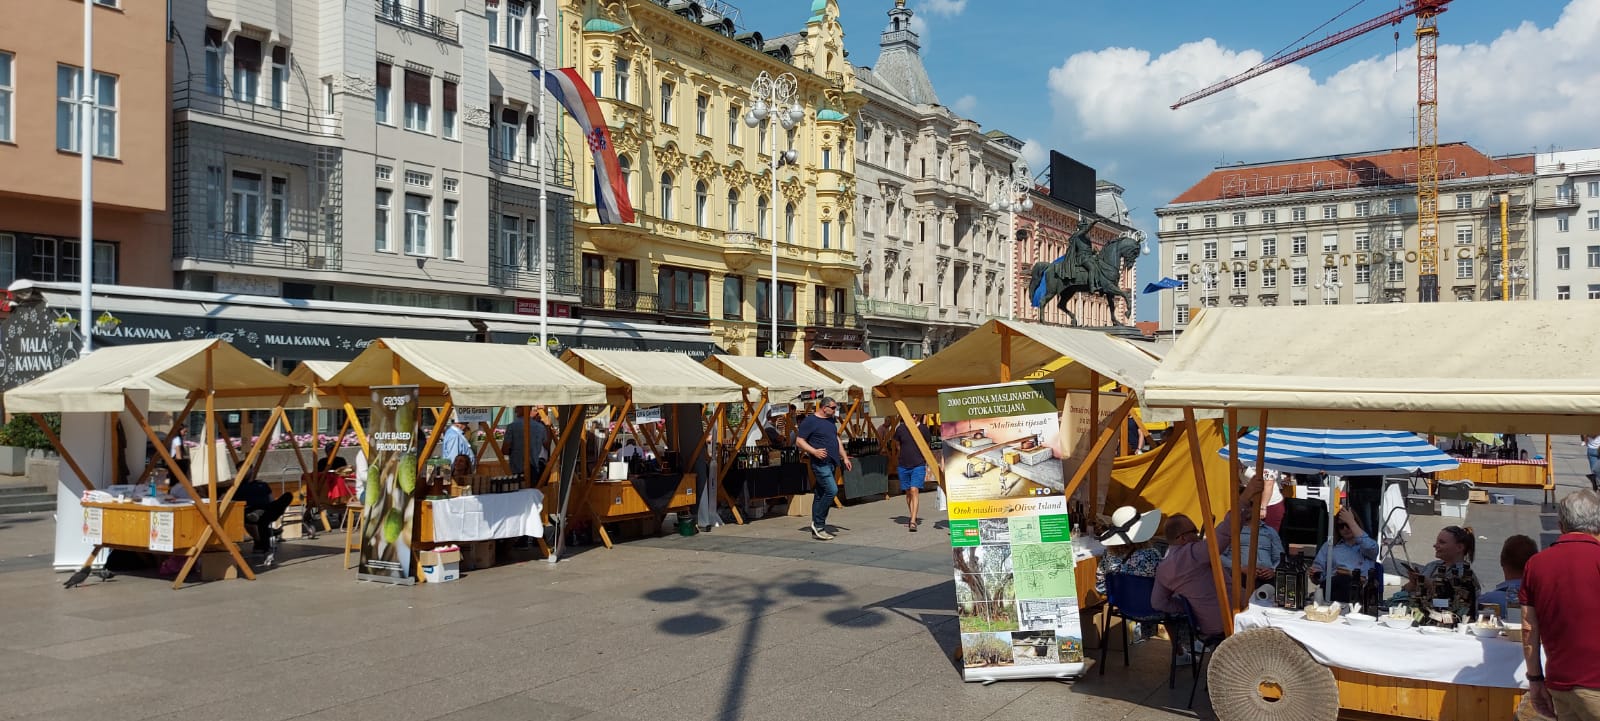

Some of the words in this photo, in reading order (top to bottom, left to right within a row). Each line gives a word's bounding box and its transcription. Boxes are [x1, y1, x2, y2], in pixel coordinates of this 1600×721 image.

[124, 327, 172, 339] KAVANA
[20, 337, 48, 352] MALA
[265, 335, 294, 346] MALA
[294, 336, 331, 347] KAVANA
[15, 355, 53, 371] KAVANA
[962, 394, 990, 406] GODINA
[991, 389, 1045, 403] MASLINARSTVA
[968, 406, 994, 416] OTOKA
[994, 402, 1026, 415] UGLJANA
[374, 432, 391, 440] OLIVE
[391, 432, 411, 440] BASED
[376, 443, 408, 451] PRODUCTS
[953, 506, 972, 515] Otok
[973, 504, 1003, 514] maslina
[1014, 502, 1036, 512] Olive
[1038, 500, 1062, 511] Island
